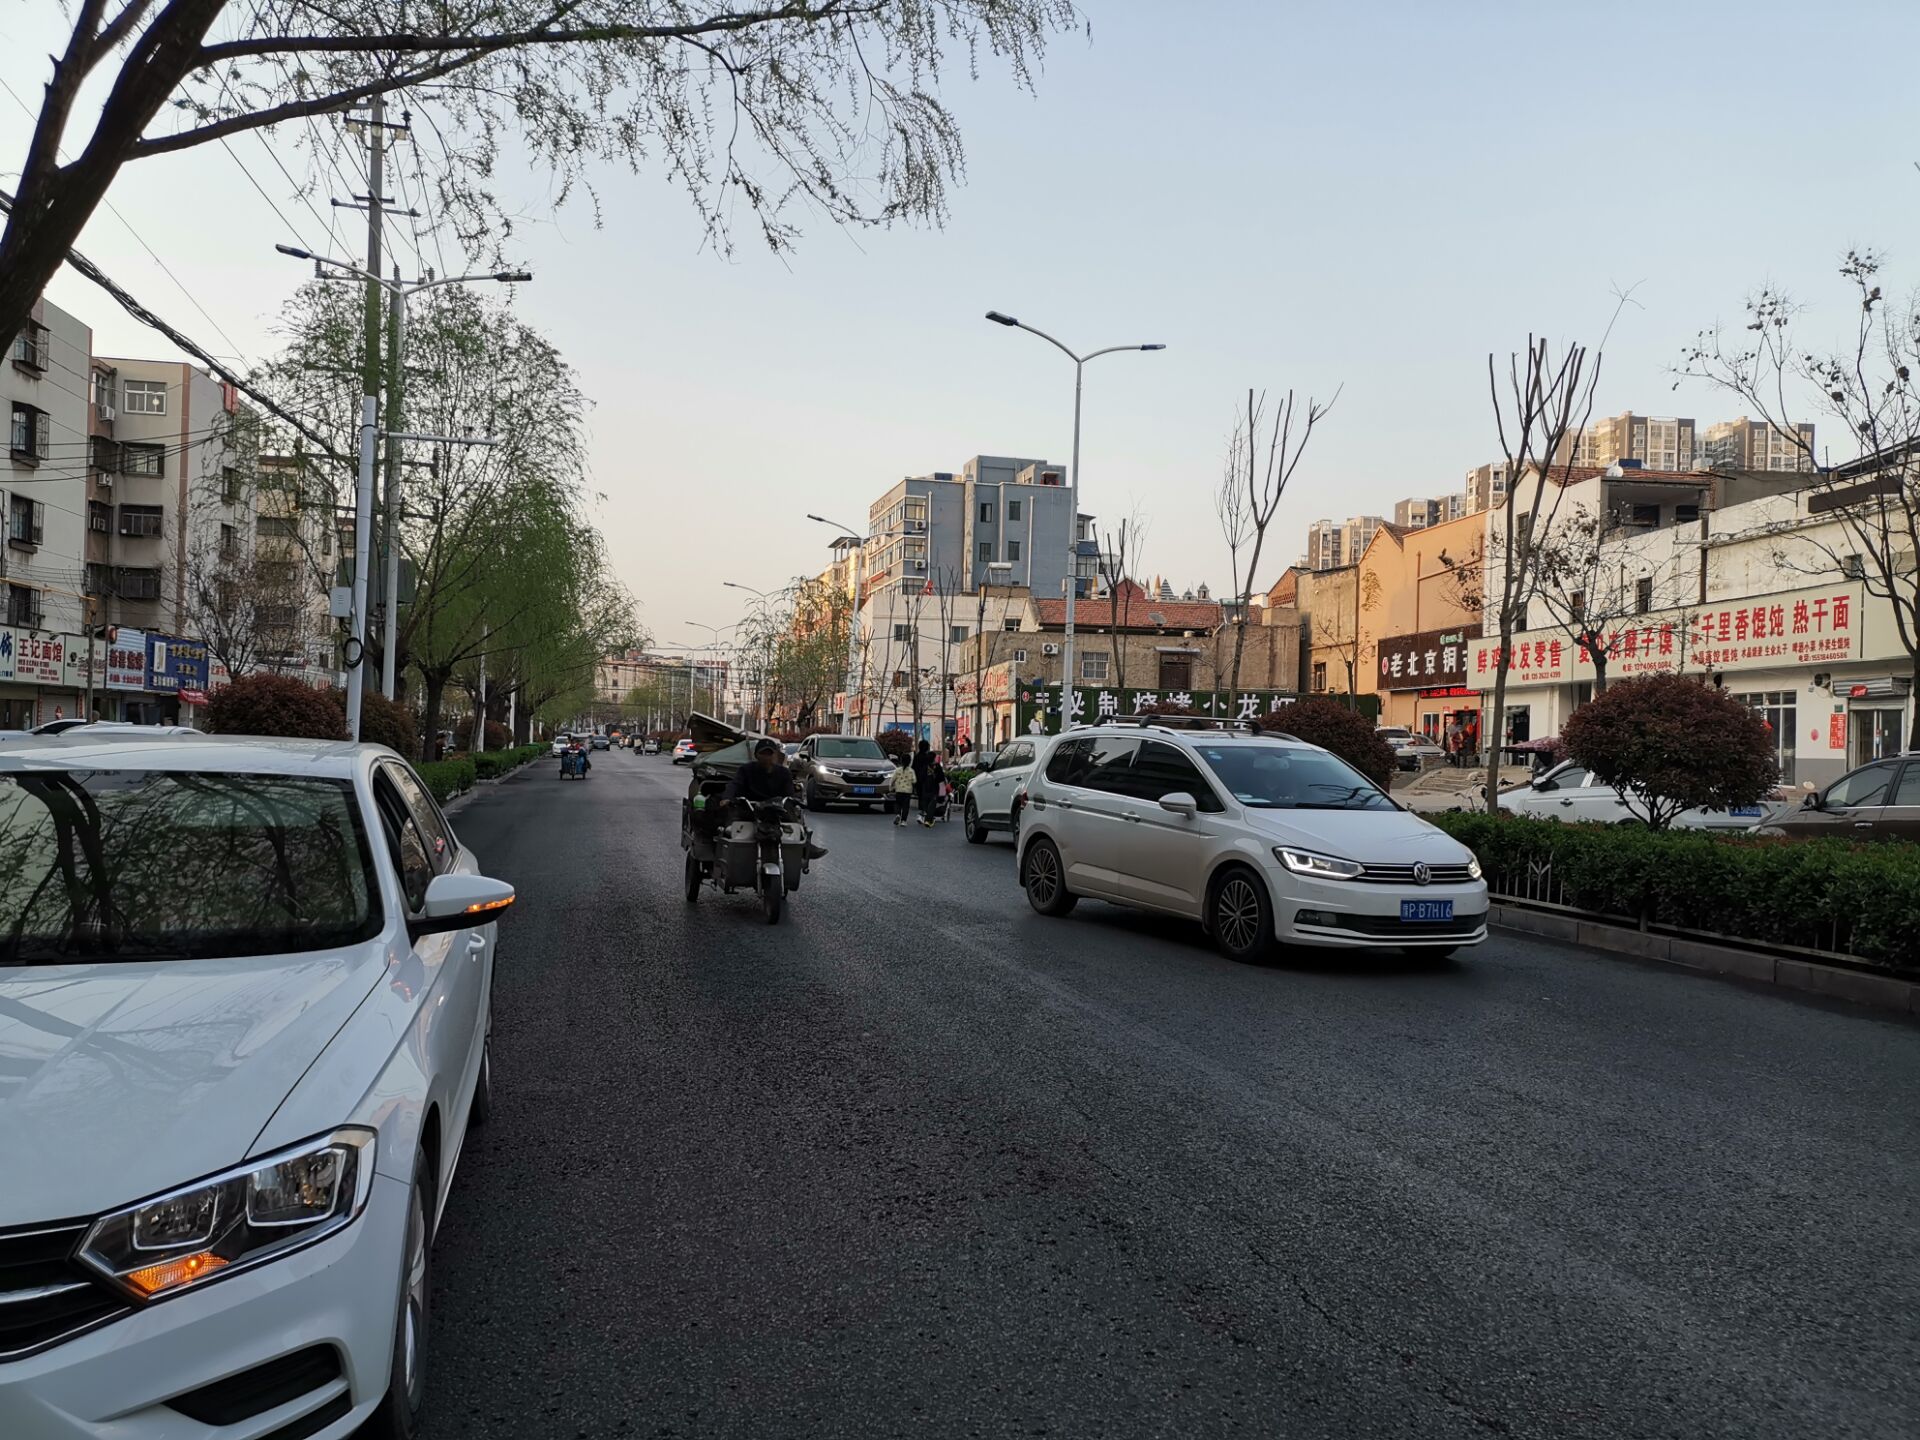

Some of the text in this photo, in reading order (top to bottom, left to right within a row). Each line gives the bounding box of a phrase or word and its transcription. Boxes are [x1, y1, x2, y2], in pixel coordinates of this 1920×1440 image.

[1701, 603, 1785, 645] 千里香馄饨
[1792, 595, 1850, 634] 热干面
[18, 638, 63, 663] 王记面馆
